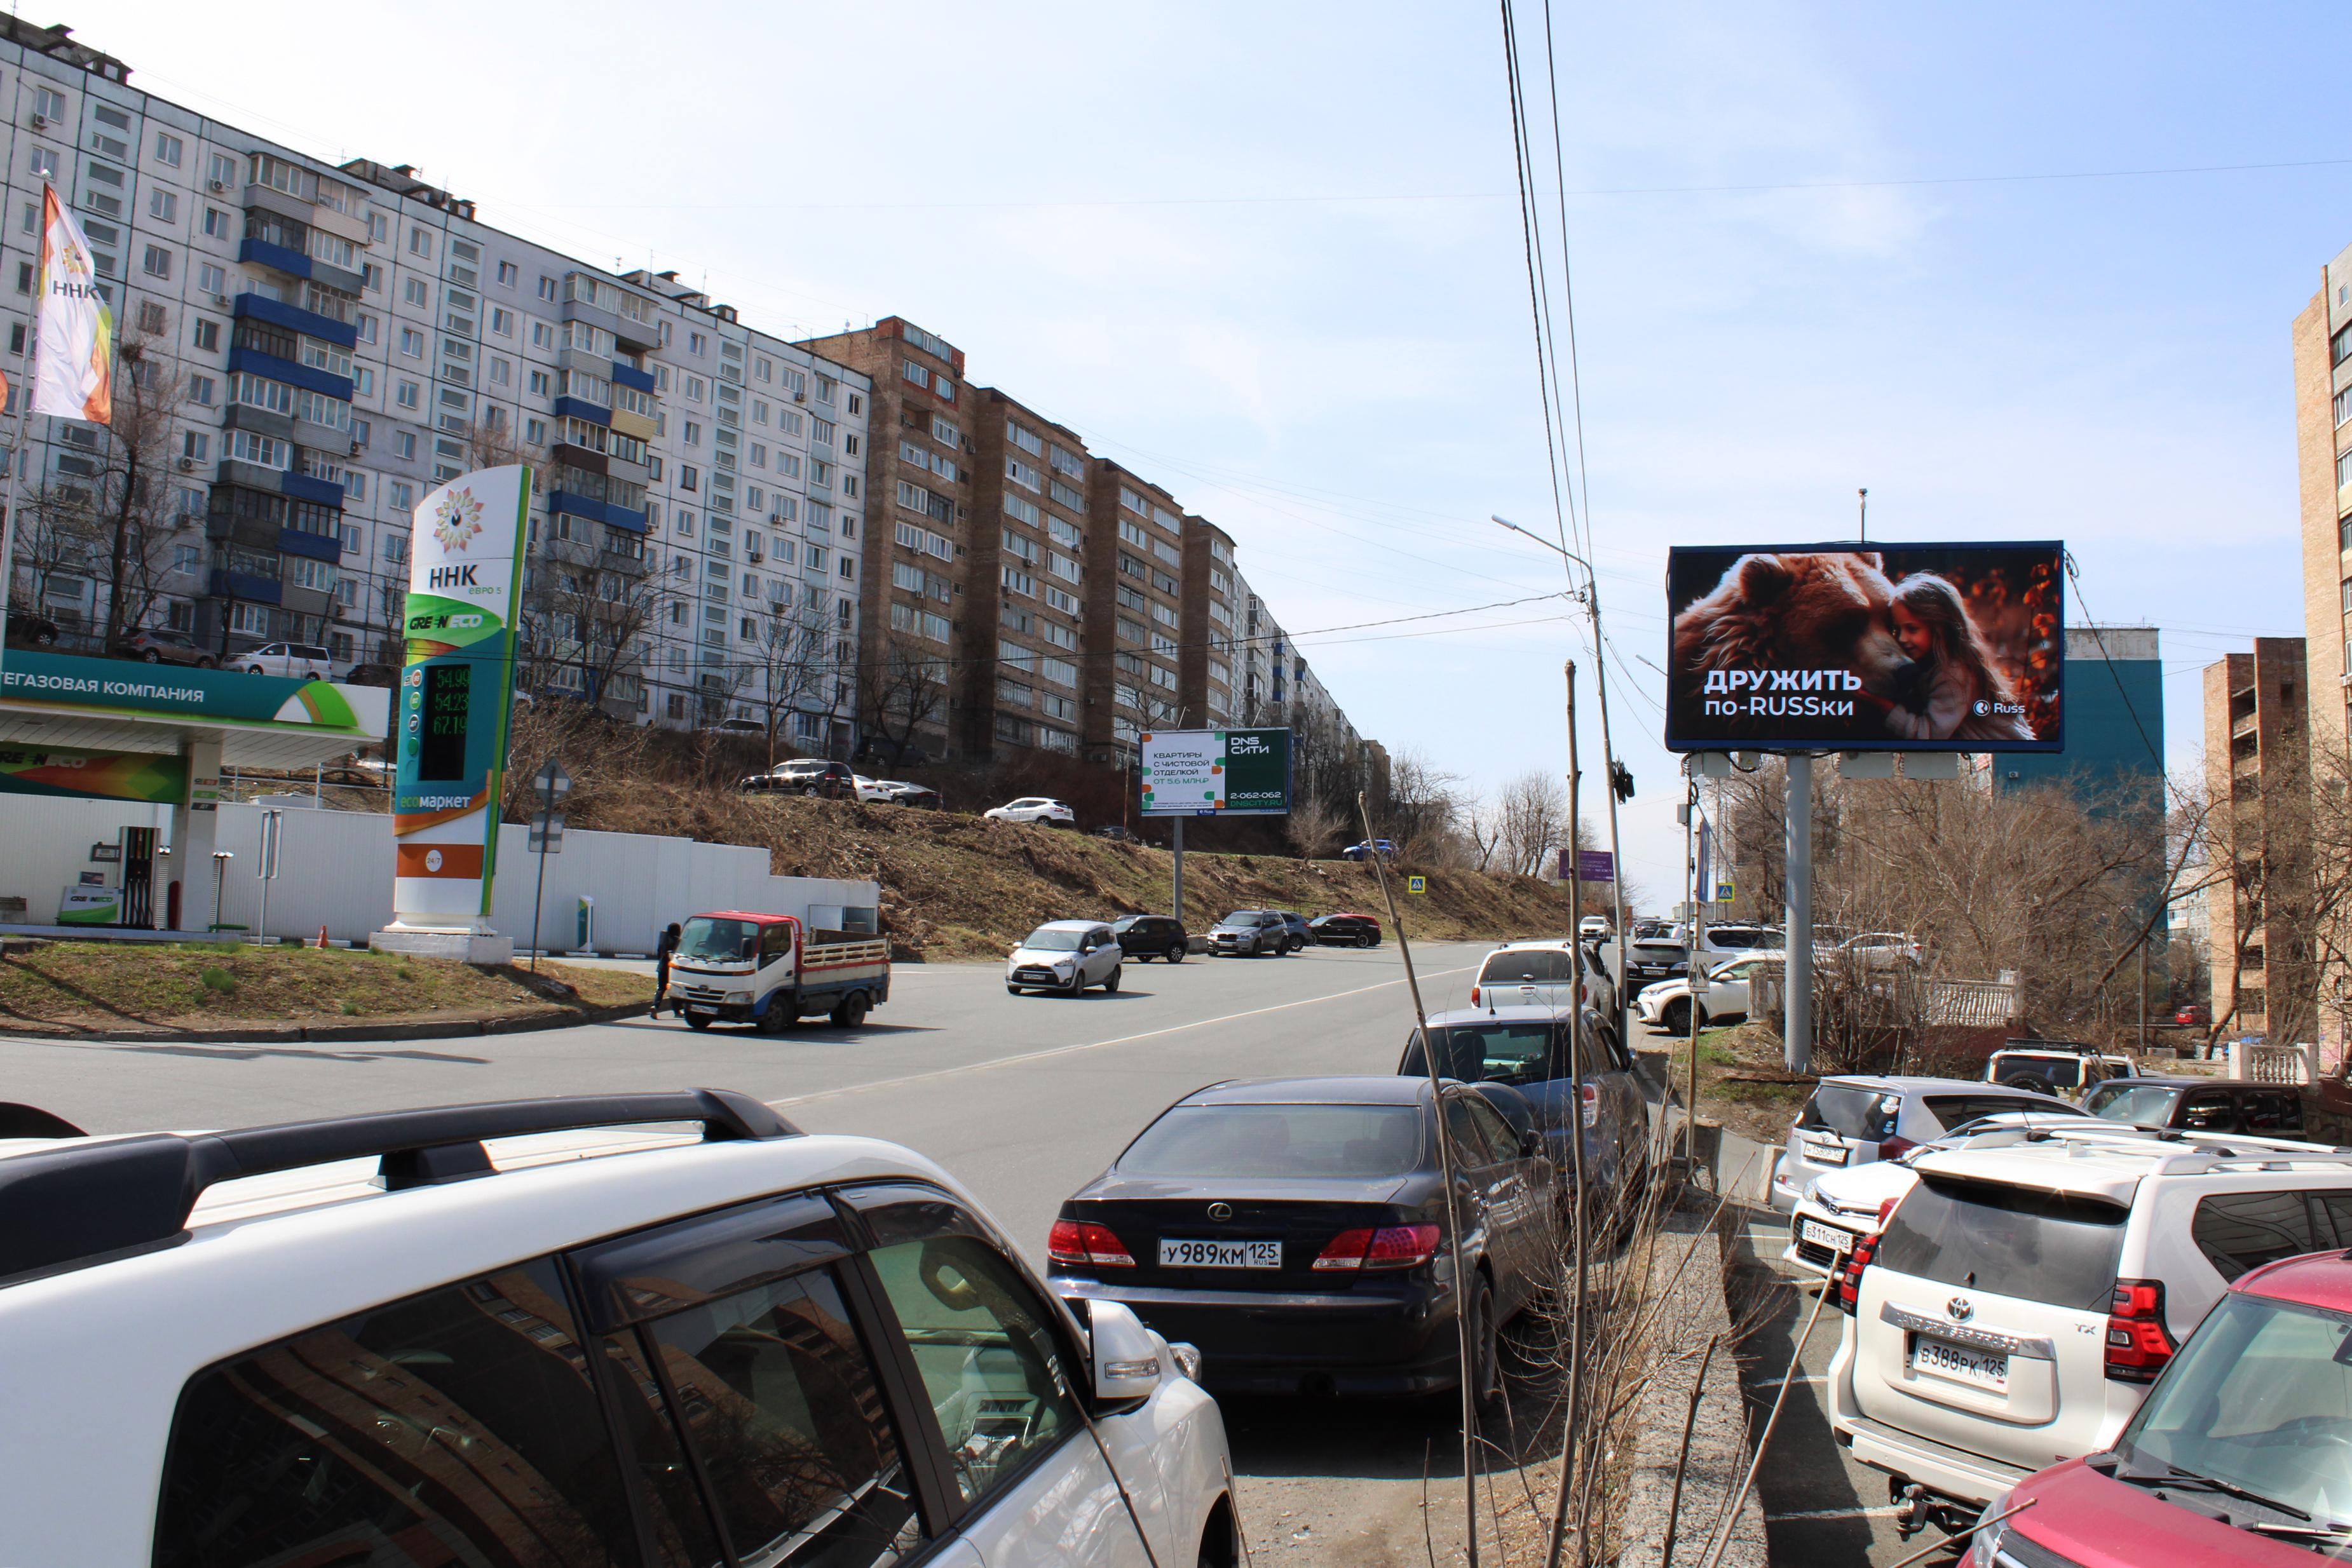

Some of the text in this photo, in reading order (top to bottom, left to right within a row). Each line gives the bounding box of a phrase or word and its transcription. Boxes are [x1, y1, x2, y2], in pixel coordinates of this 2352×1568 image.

[430, 564, 479, 589] ННК
[496, 586, 502, 595] 5
[103, 681, 204, 703] КОМПАНИЯ
[1704, 670, 1861, 694] ДРУЖИТЬ
[1705, 696, 1853, 715] по-RUSSки
[1994, 703, 2025, 714] Russ
[1231, 737, 1260, 745] DNS
[1231, 746, 1269, 754] СИТИ
[1167, 1243, 1277, 1265] У989КМ 125
[1921, 1346, 2005, 1377] В388РК 125
